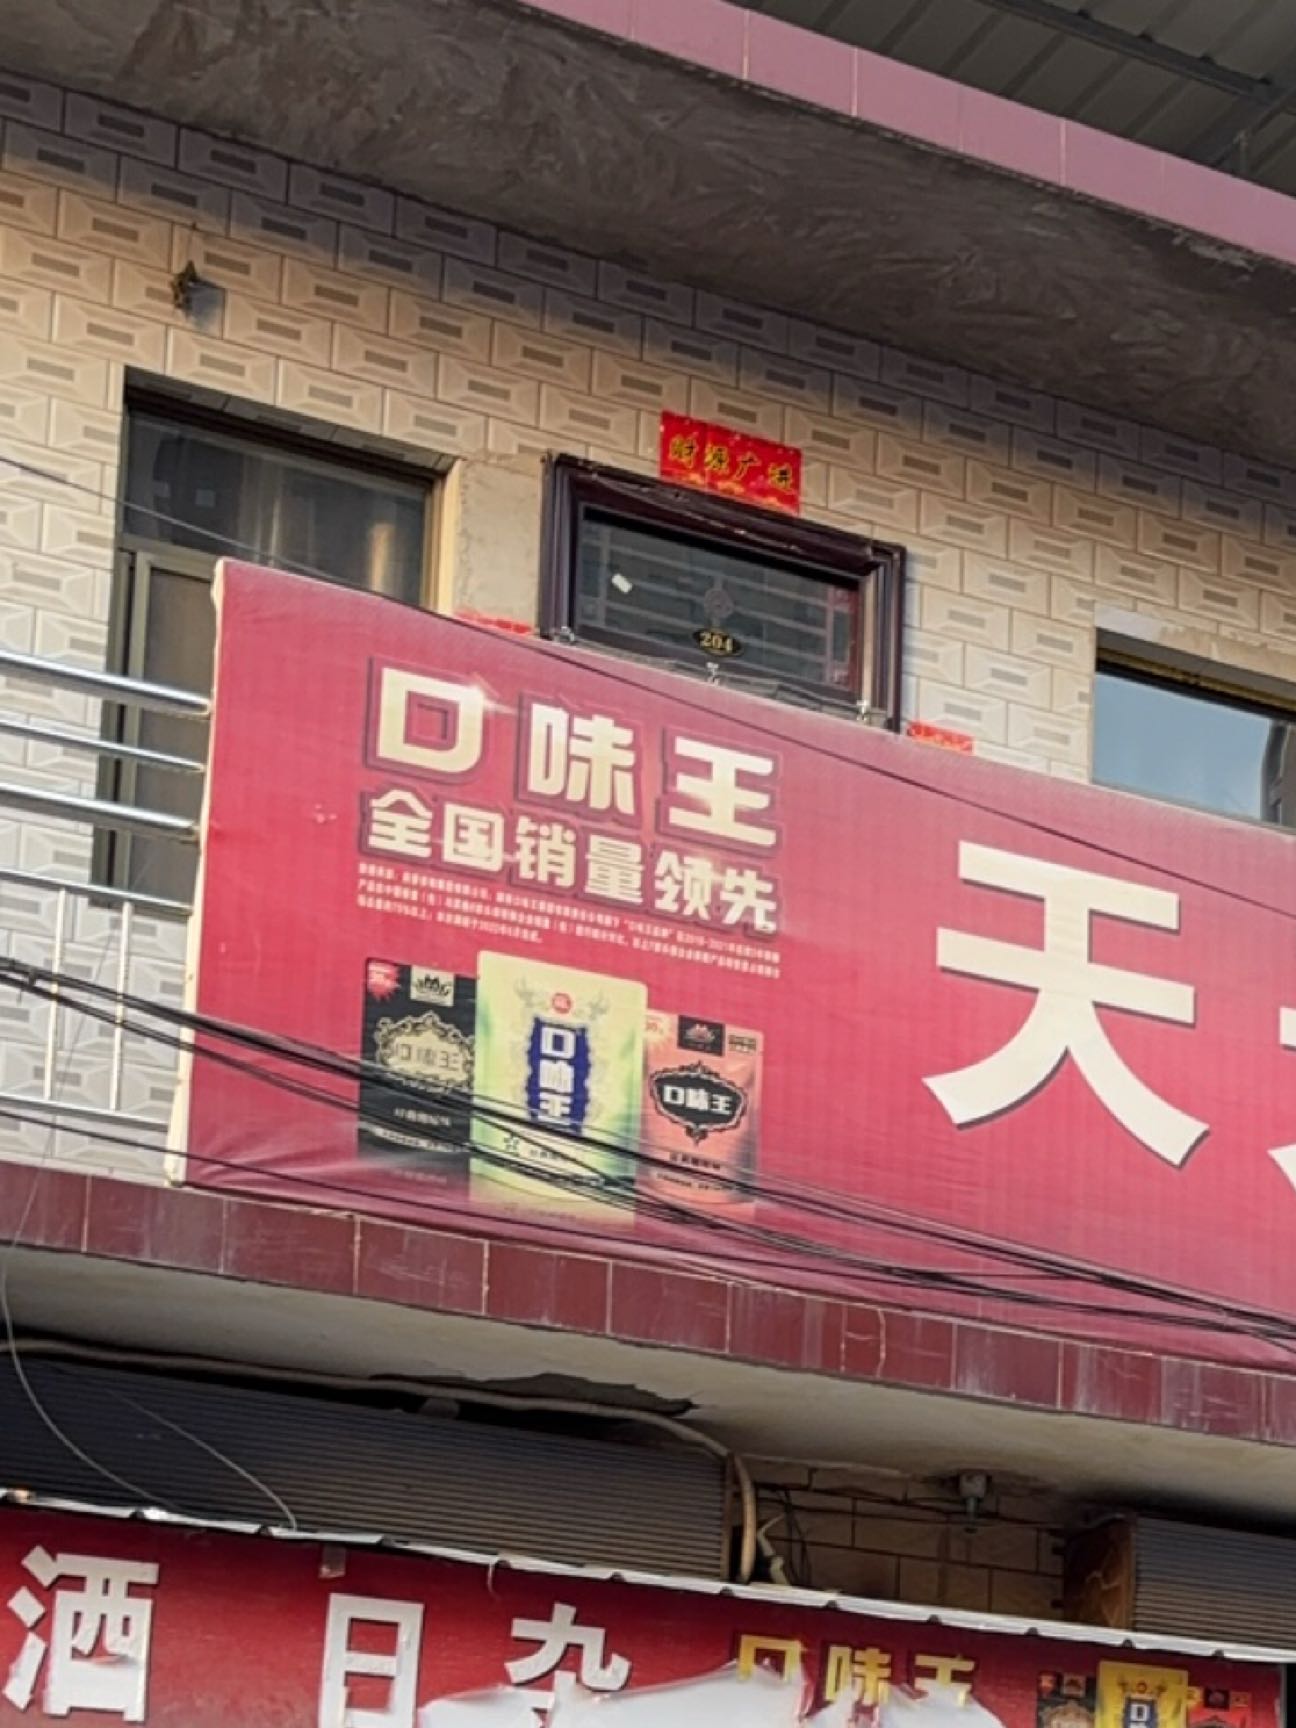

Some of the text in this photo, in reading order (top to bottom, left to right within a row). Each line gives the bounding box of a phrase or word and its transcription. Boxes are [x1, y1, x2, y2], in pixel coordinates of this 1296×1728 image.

[375, 667, 776, 846] 口味王
[368, 788, 779, 934] 全国销量领先
